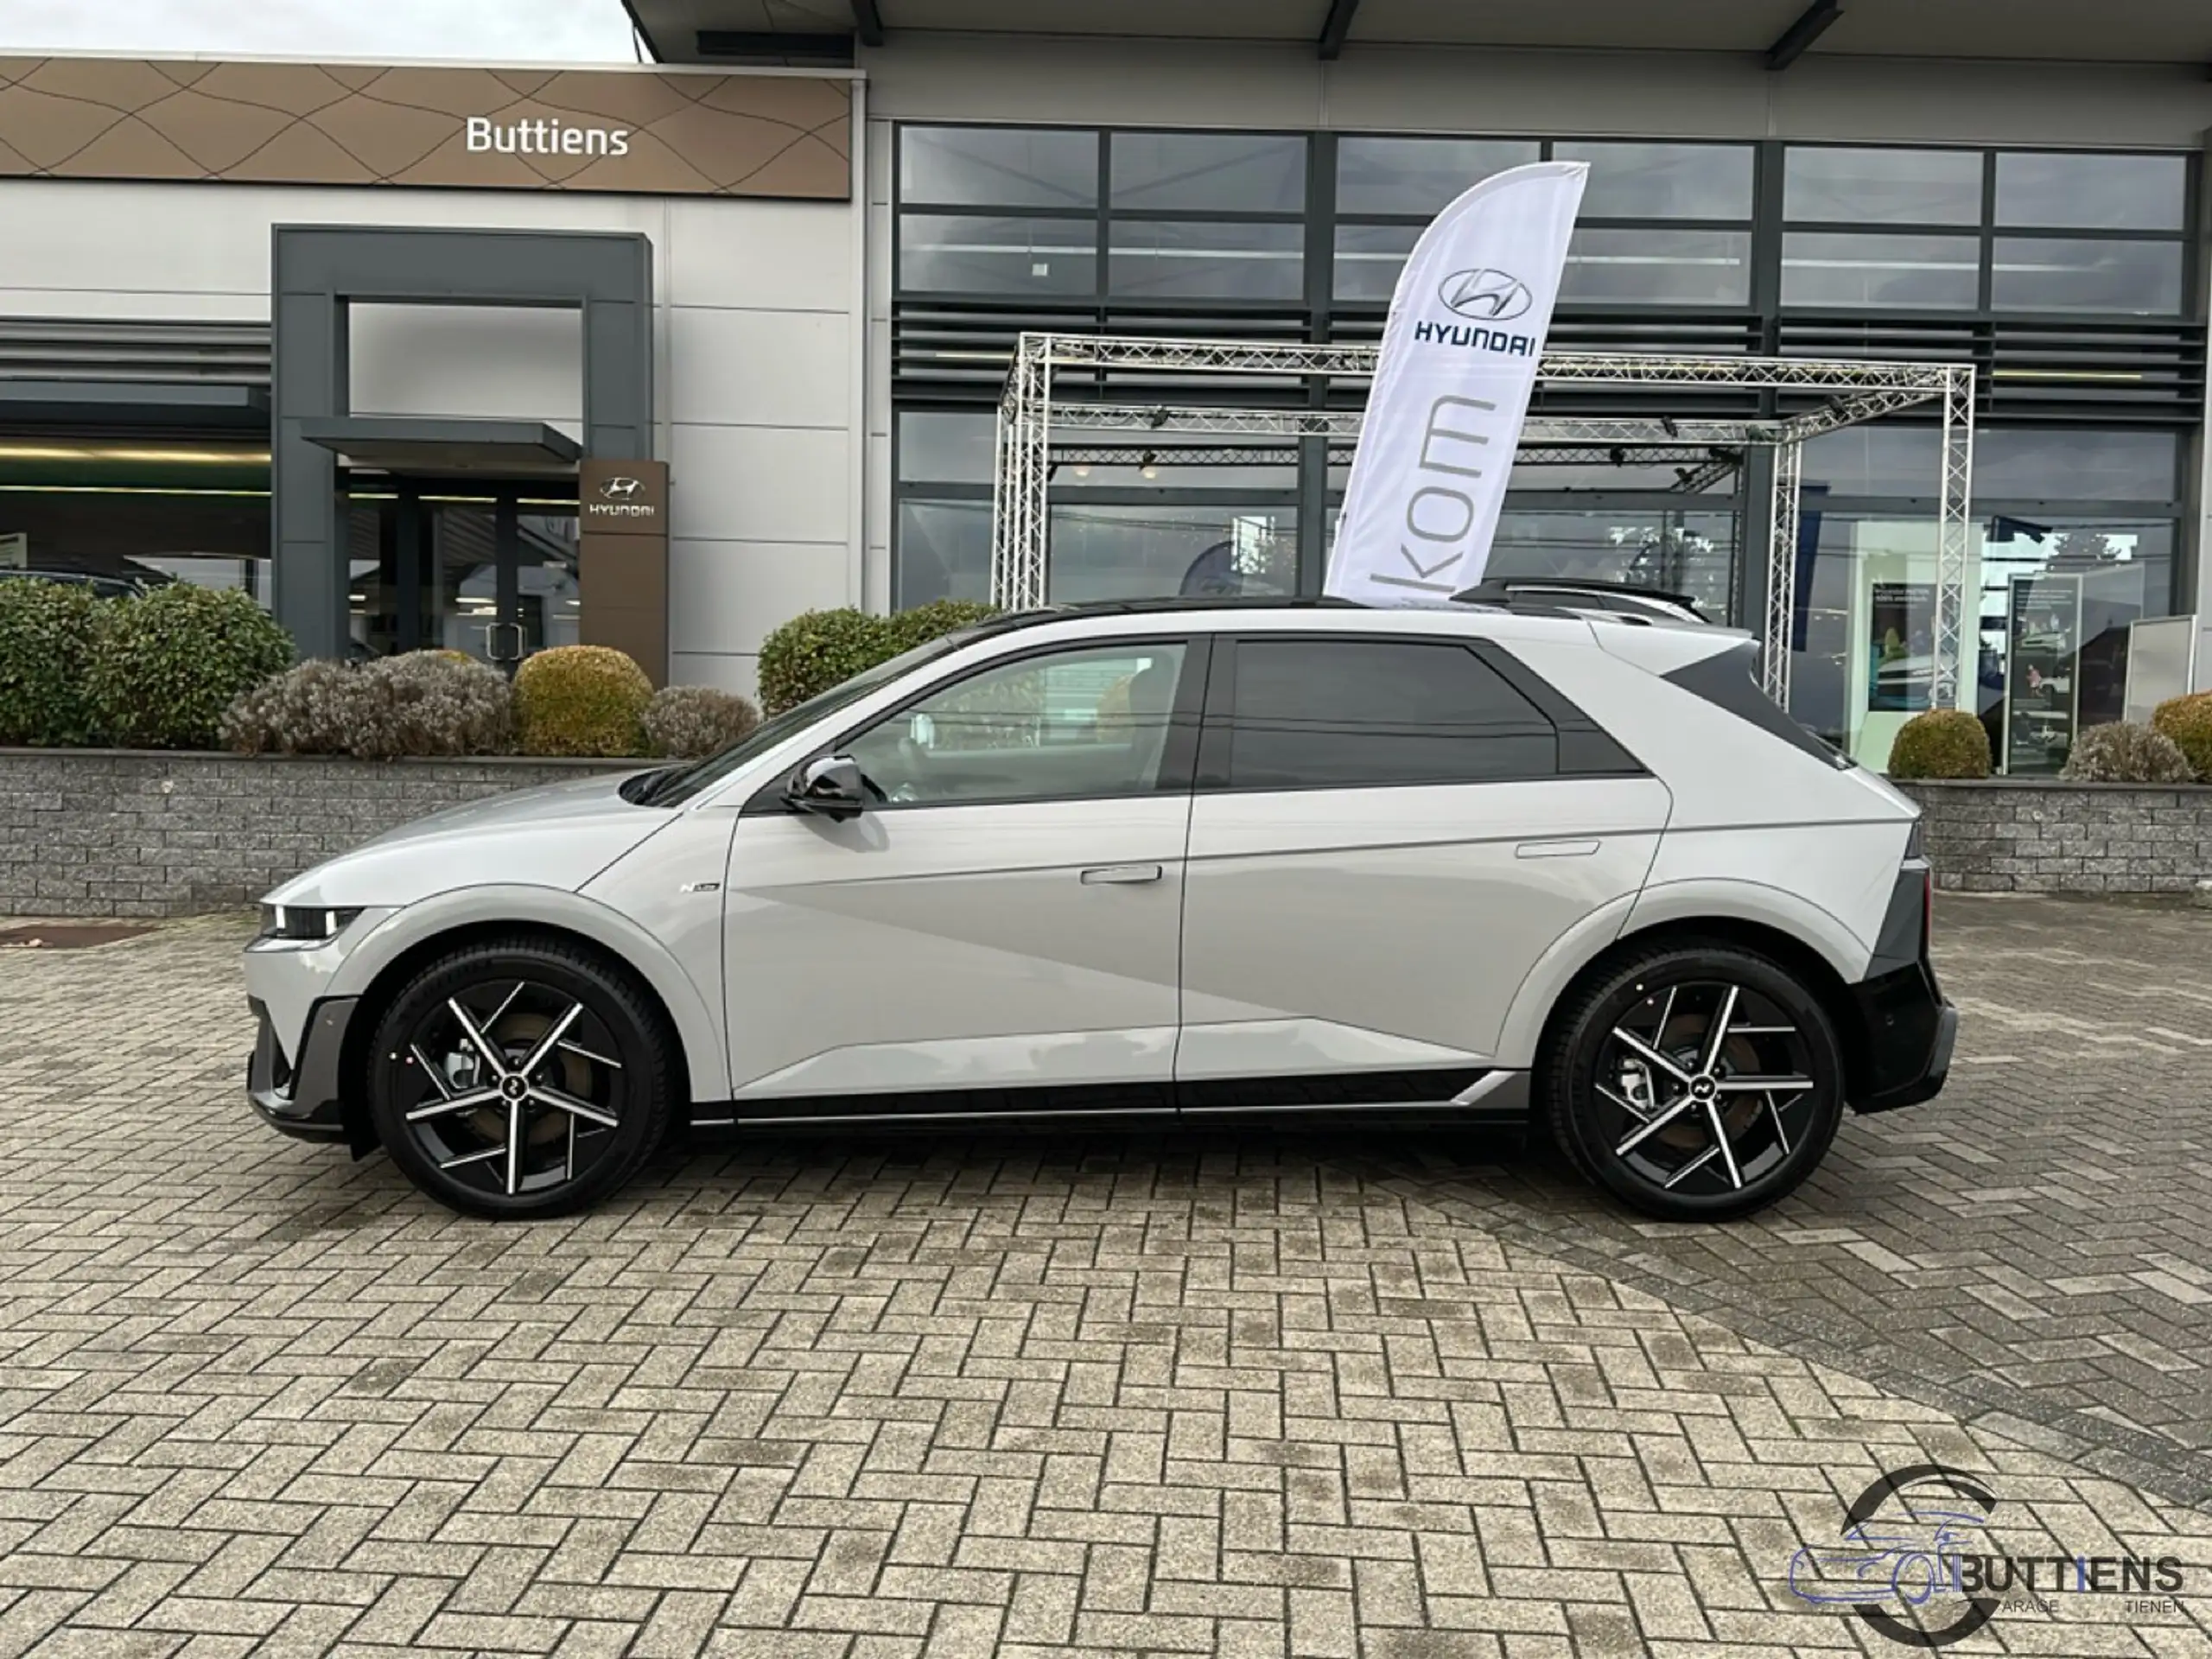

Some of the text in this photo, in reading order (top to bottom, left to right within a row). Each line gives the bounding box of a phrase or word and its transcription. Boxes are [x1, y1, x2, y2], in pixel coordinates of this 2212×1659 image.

[467, 117, 628, 156] Buttiens
[1414, 321, 1535, 357] HYUNDAI
[589, 504, 654, 516] HYUNDAI
[1370, 395, 1496, 594] kom
